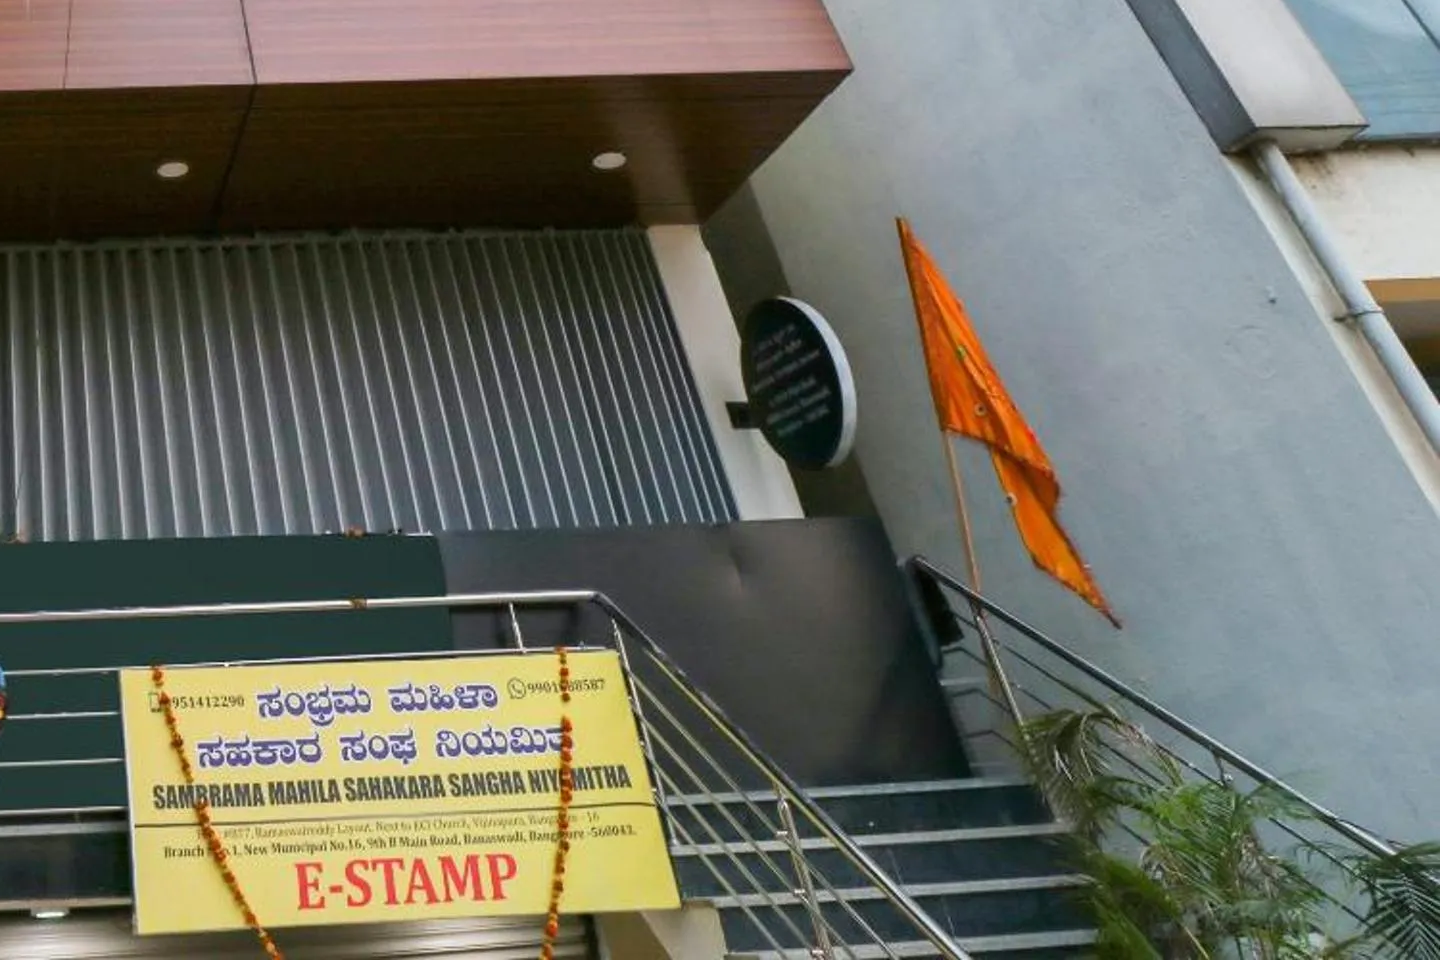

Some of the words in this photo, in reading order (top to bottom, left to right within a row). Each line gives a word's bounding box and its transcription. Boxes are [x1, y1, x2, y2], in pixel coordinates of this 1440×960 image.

[257, 684, 371, 726] ಸಂಭ್ರಮ
[388, 681, 498, 713] ಮಹಿಳಾ
[197, 732, 322, 768] ಸಹಕಾರ
[340, 726, 417, 765] ಸಂಘ
[153, 783, 264, 809] SAMBRAMA
[268, 778, 341, 805] MAHILA
[344, 774, 446, 802] SAHAKARA
[449, 771, 526, 798] SANGHA
[528, 765, 632, 793] NIYMITHA
[164, 844, 205, 858] Branch
[243, 842, 268, 855] New
[271, 838, 327, 855] Municipal
[399, 835, 428, 848] Main
[295, 854, 517, 910] E-STAMP
